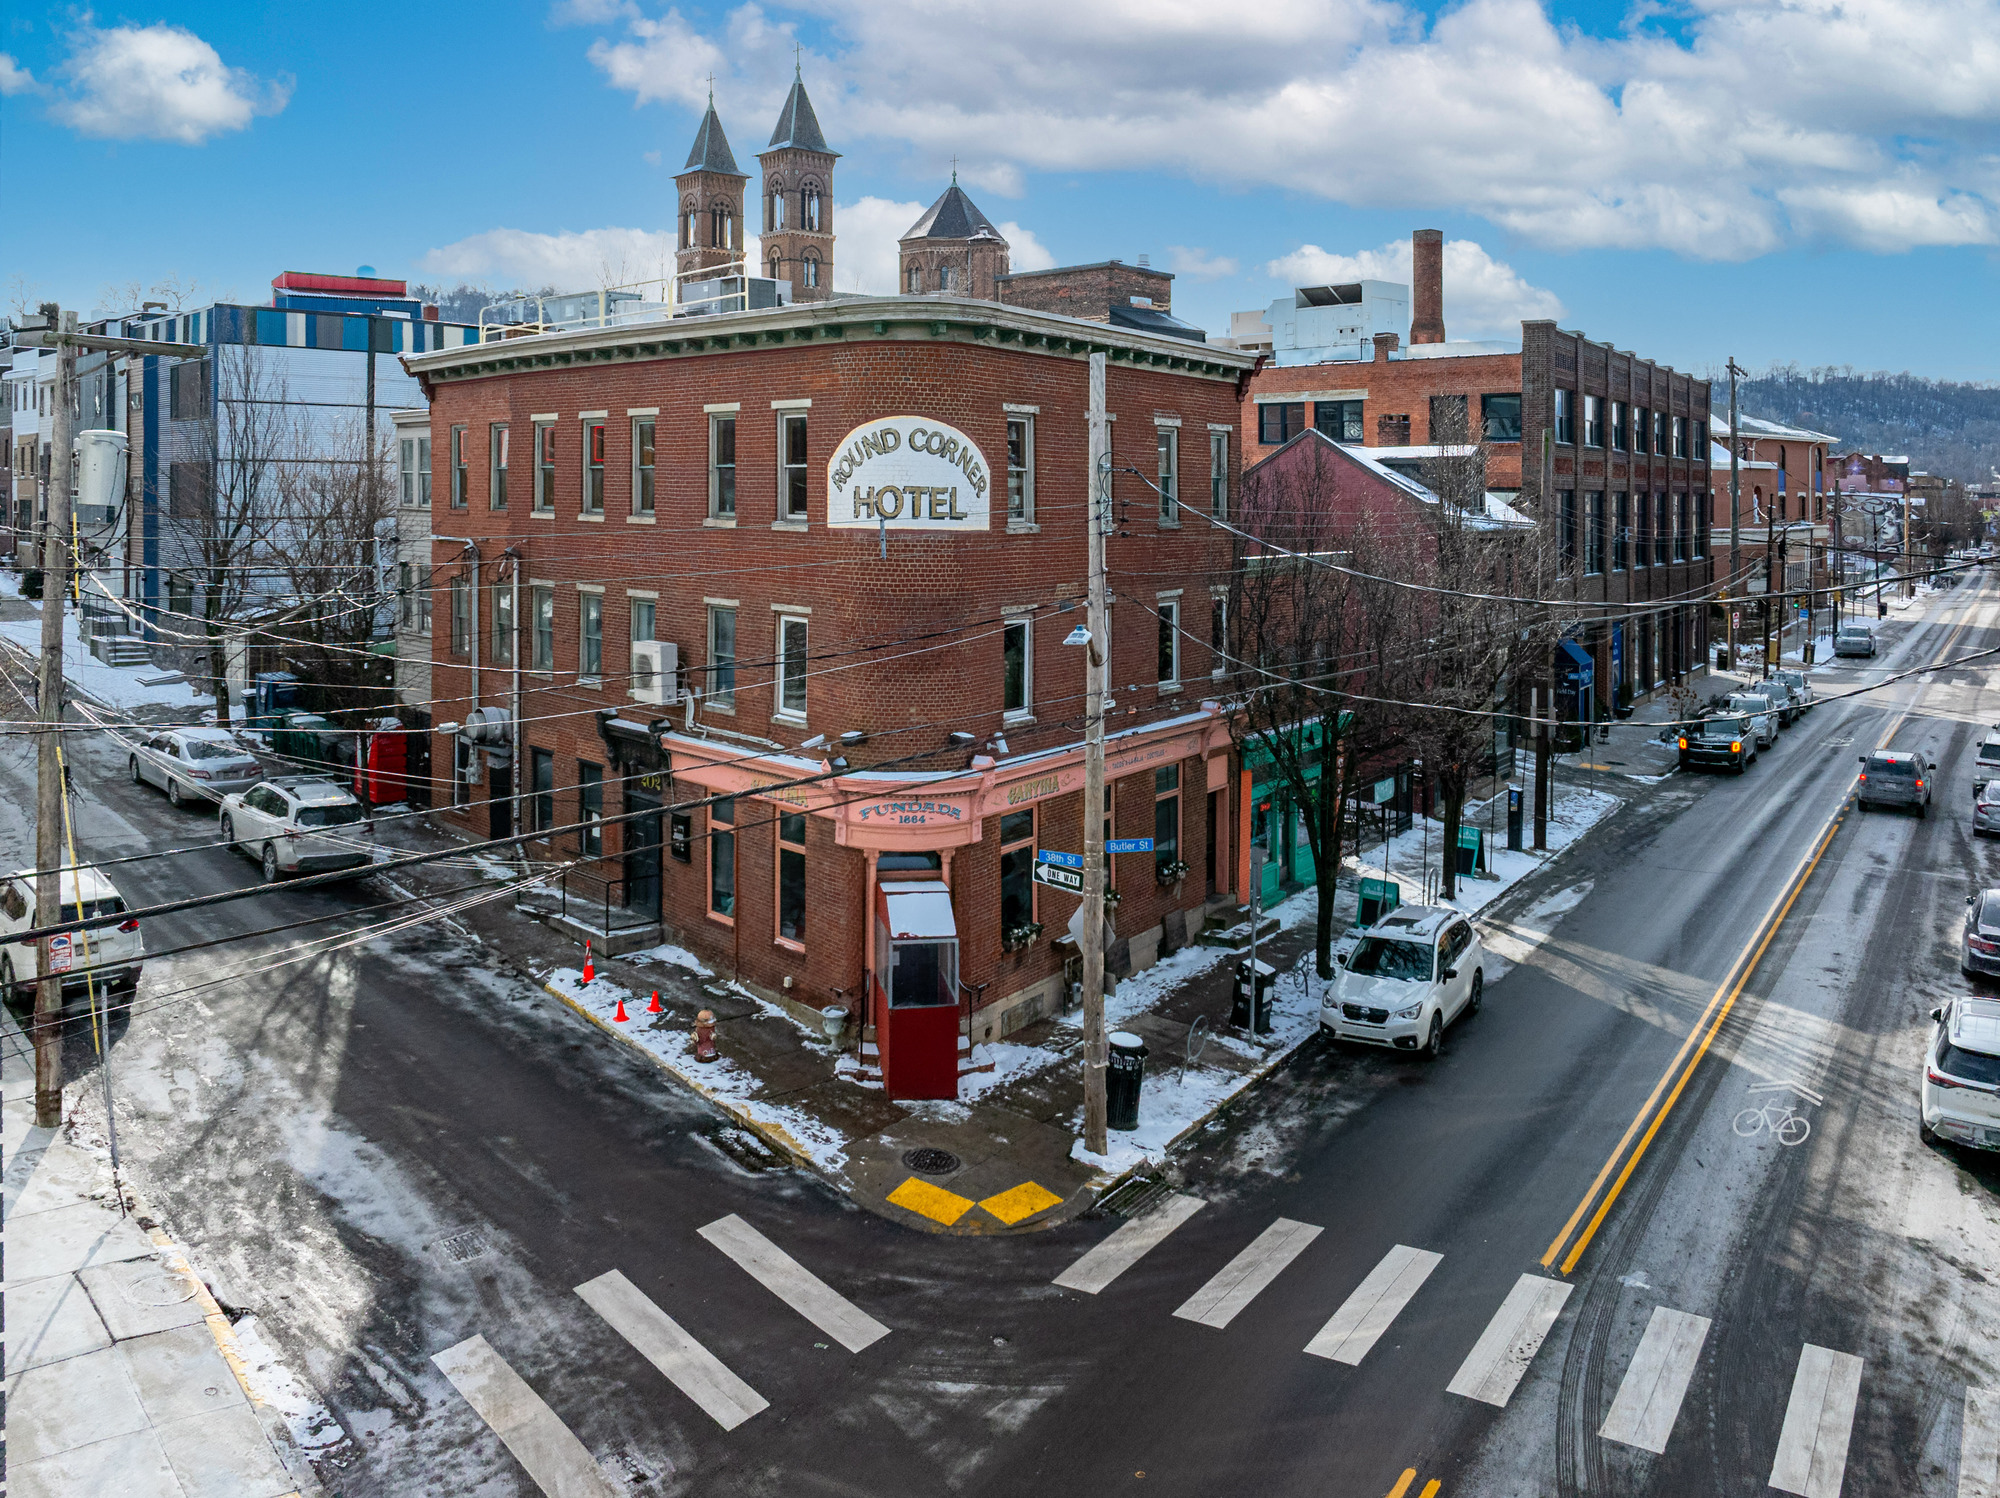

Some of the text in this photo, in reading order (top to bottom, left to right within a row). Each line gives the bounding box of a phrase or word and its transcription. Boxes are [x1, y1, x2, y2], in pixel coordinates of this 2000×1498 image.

[831, 427, 987, 499] ROUND CORNER
[853, 485, 968, 521] HOTEL
[1007, 775, 1060, 805] CANTINA
[859, 801, 962, 821] FUNDADA
[898, 815, 926, 824] 1864
[1110, 841, 1149, 851] Butler St
[1045, 852, 1076, 865] 38th St
[1047, 869, 1079, 885] ONE WAY
